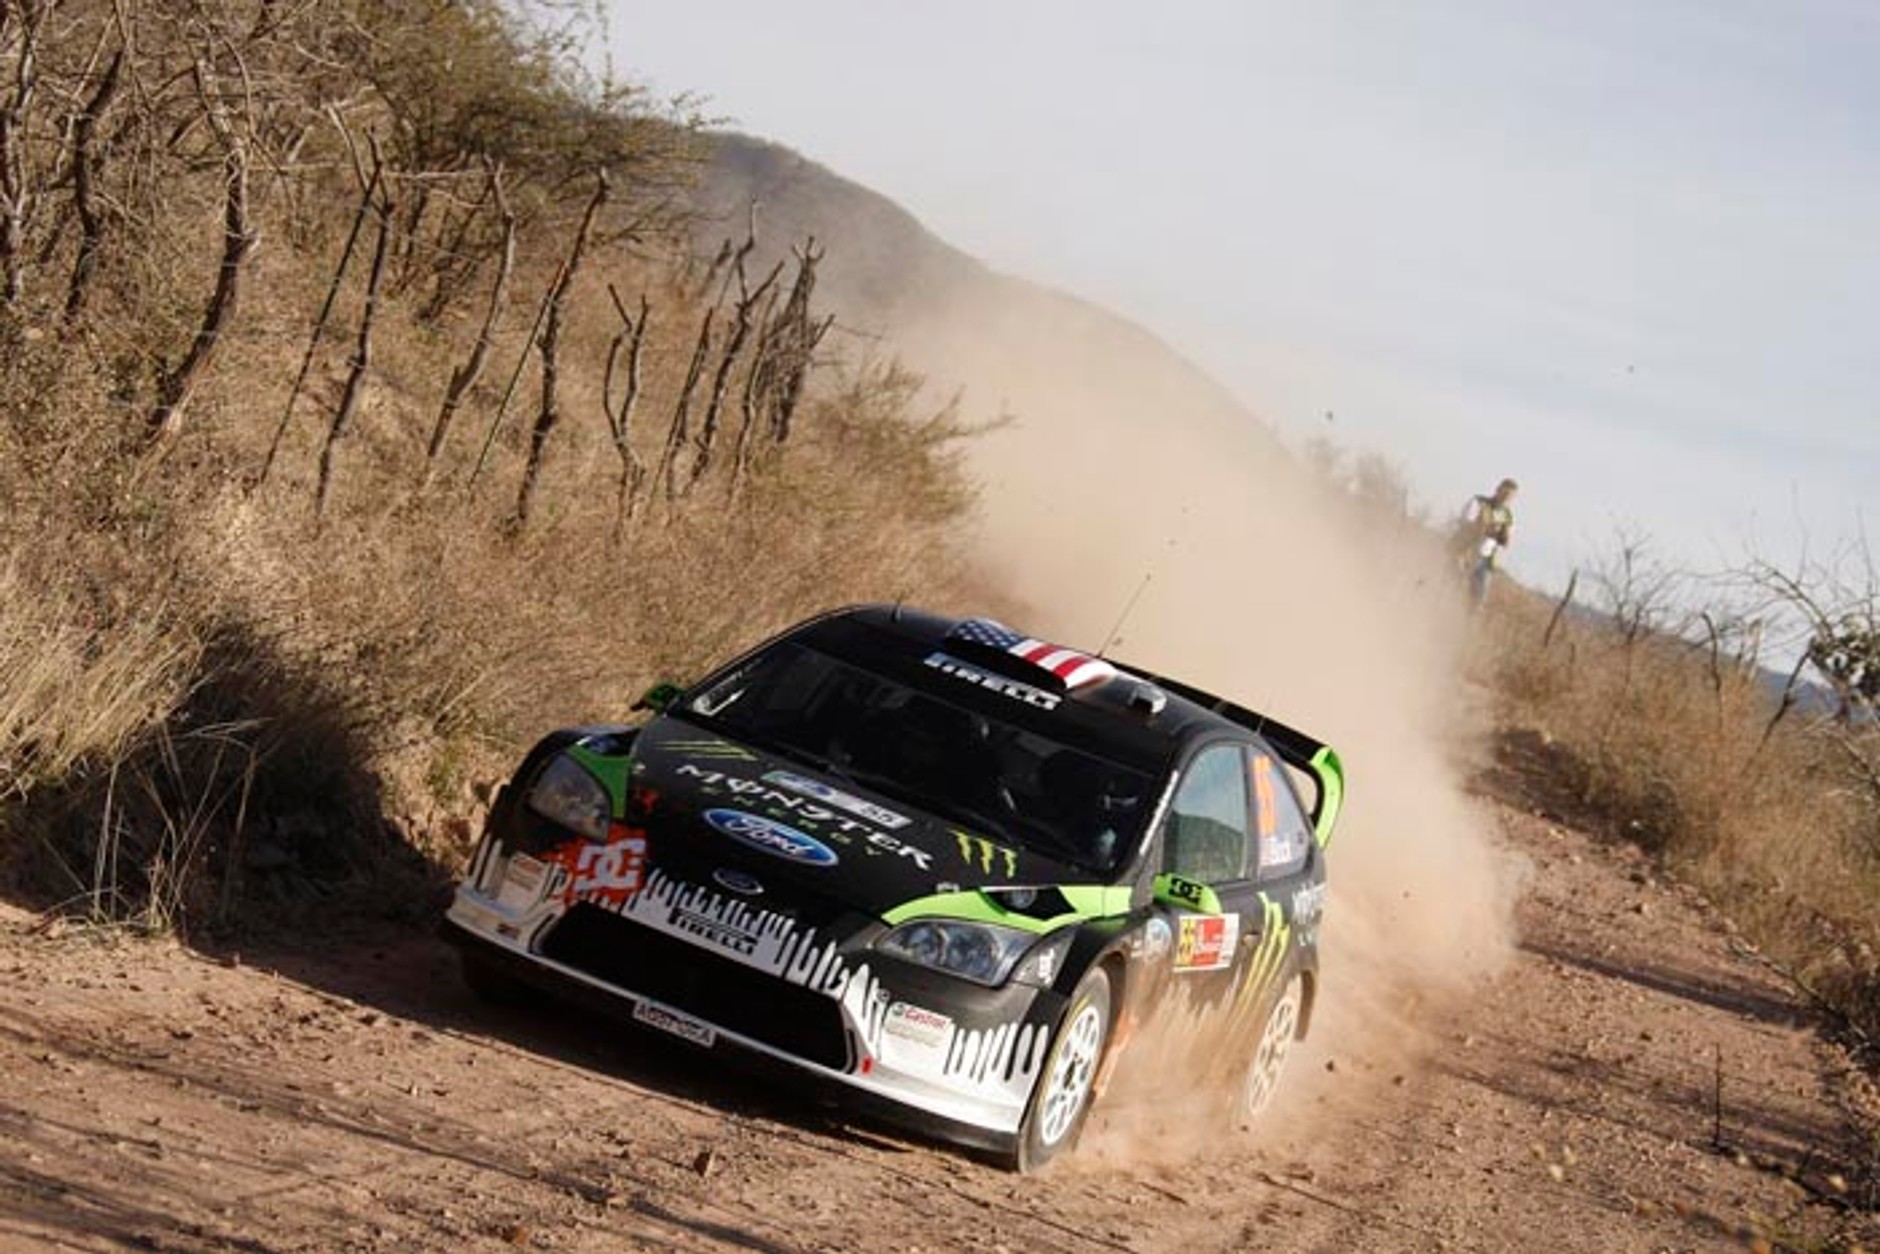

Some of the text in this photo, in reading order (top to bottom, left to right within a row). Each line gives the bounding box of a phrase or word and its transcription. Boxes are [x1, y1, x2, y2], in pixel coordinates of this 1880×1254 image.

[676, 764, 933, 870] MONSTER
[724, 817, 814, 855] Ford
[573, 838, 647, 890] DC
